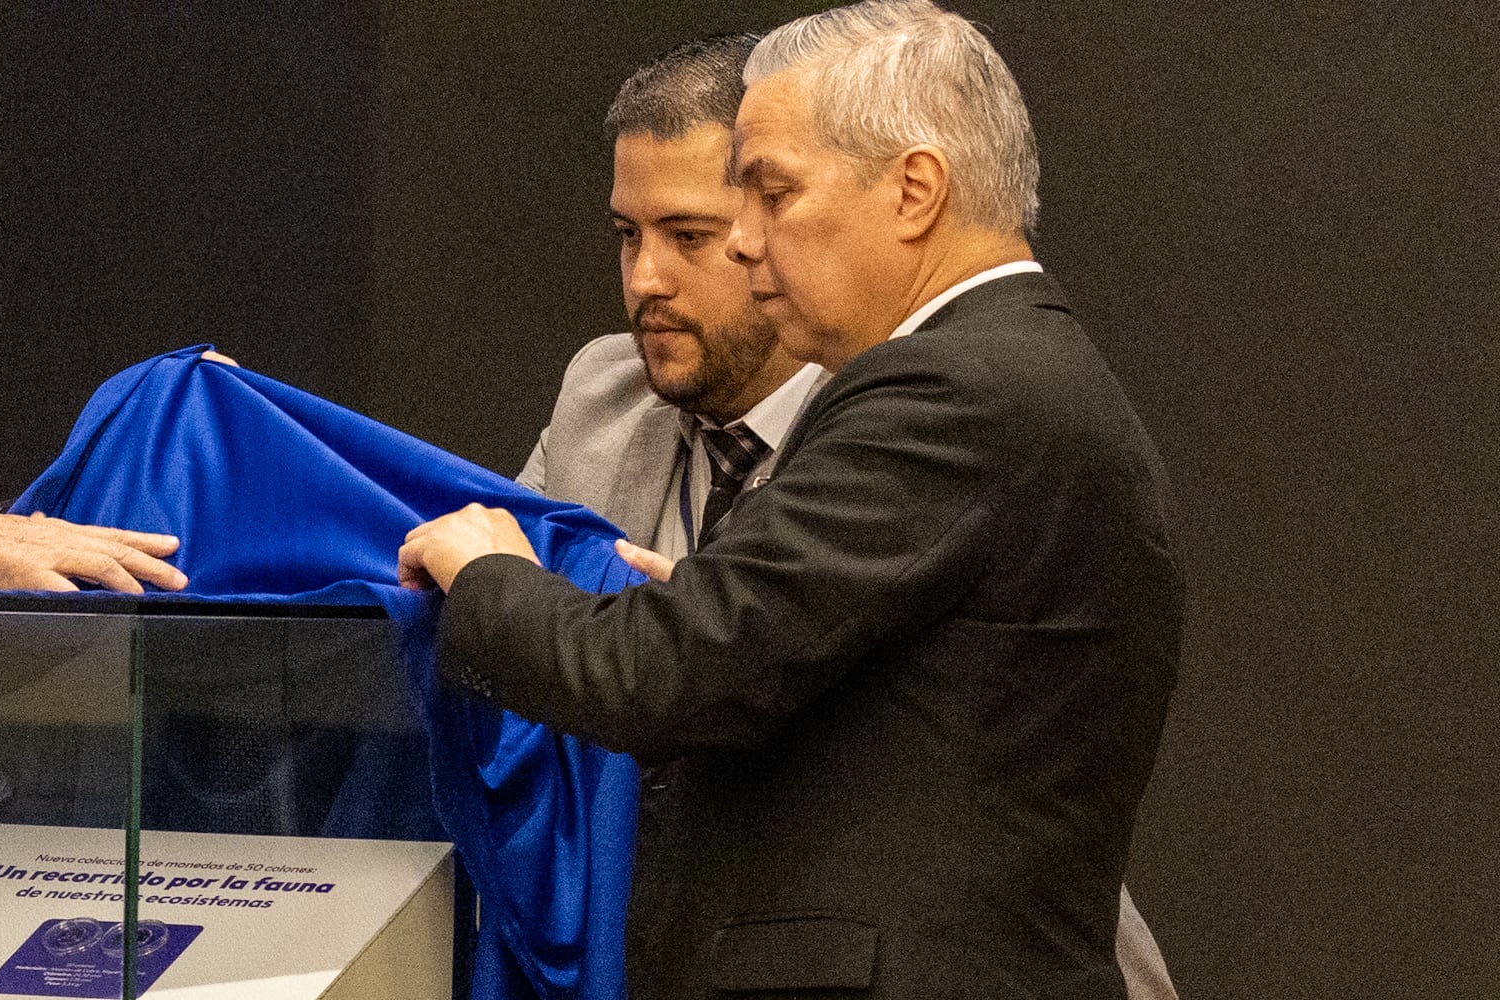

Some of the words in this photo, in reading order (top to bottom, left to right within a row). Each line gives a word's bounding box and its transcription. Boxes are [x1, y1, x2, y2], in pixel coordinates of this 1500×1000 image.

[35, 854, 76, 863] Nueva
[147, 859, 164, 867] de
[165, 861, 223, 870] monedas
[226, 862, 244, 871] de
[244, 863, 264, 872] 50
[264, 865, 318, 874] colones:
[164, 875, 220, 890] por
[220, 875, 250, 890] la
[252, 876, 336, 894] fauna
[15, 886, 42, 898] de
[146, 894, 274, 909] ecosistemas
